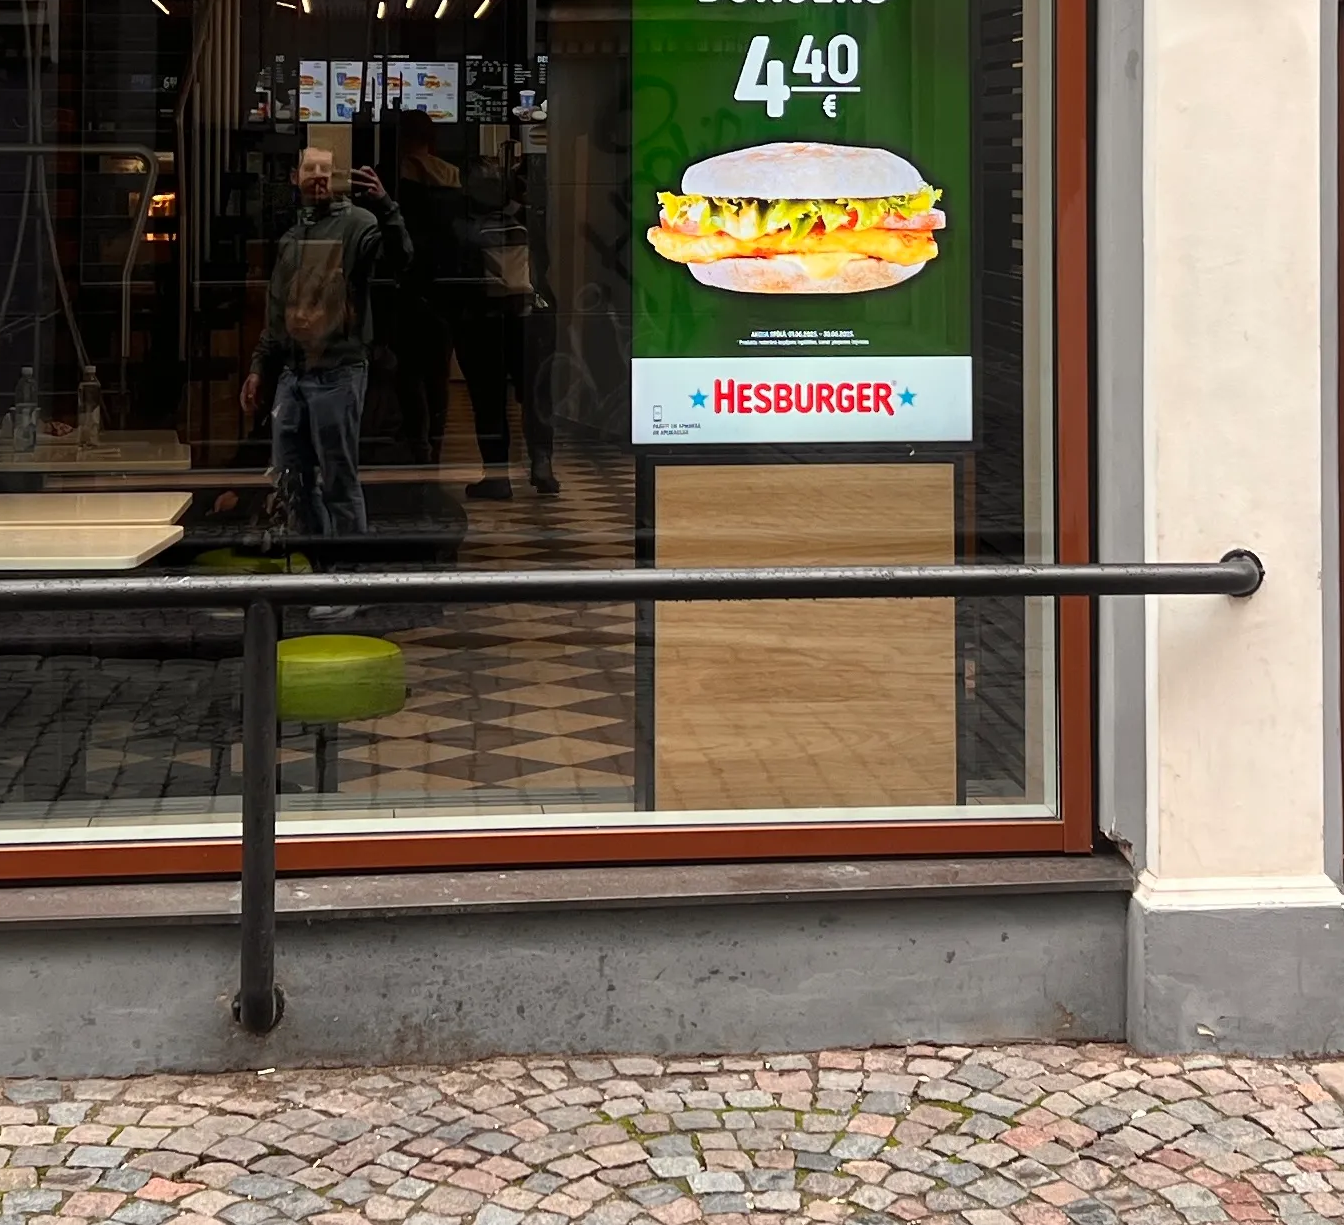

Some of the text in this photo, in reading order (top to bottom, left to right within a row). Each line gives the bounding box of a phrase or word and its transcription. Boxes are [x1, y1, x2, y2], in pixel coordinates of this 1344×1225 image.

[733, 34, 859, 118] 4 40
[822, 94, 837, 118] €
[713, 378, 895, 416] HESBURGER
